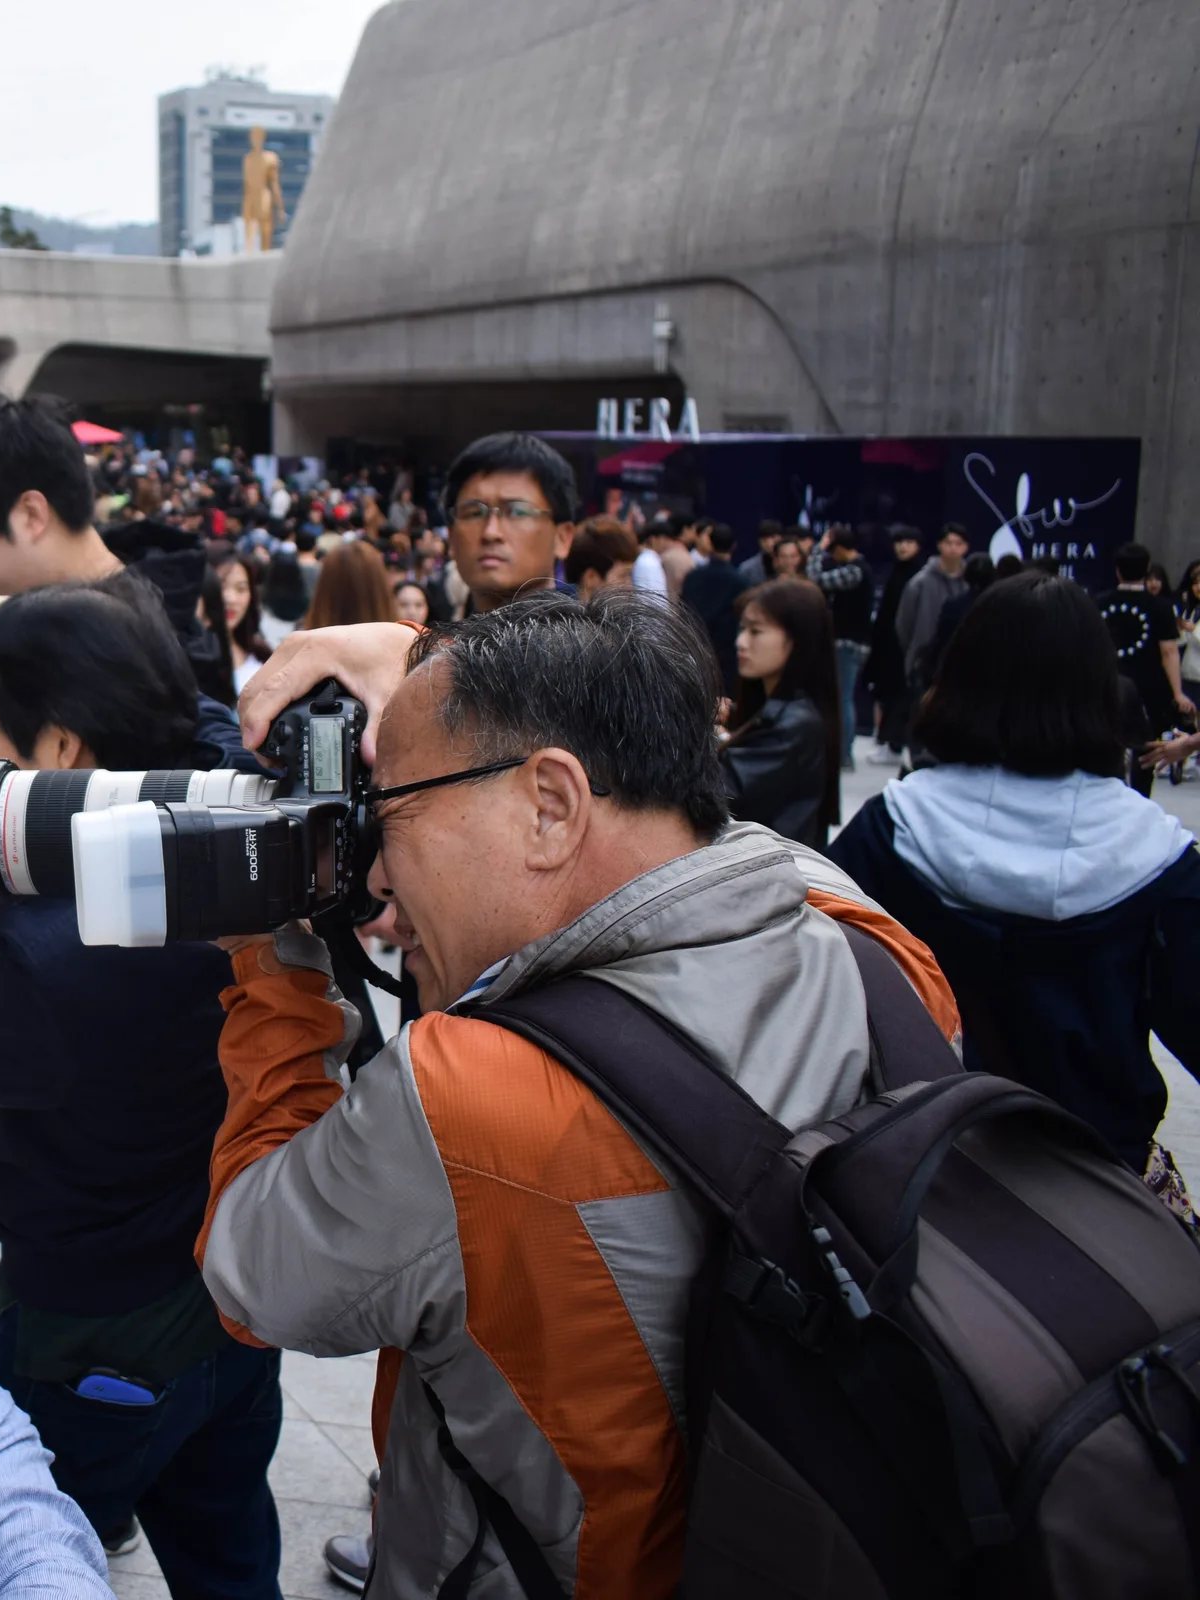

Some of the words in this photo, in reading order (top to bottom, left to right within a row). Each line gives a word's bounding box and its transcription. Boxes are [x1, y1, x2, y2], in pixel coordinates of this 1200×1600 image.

[596, 396, 701, 443] HERA
[1031, 542, 1097, 560] HERA
[249, 828, 258, 882] 600EX-RT
